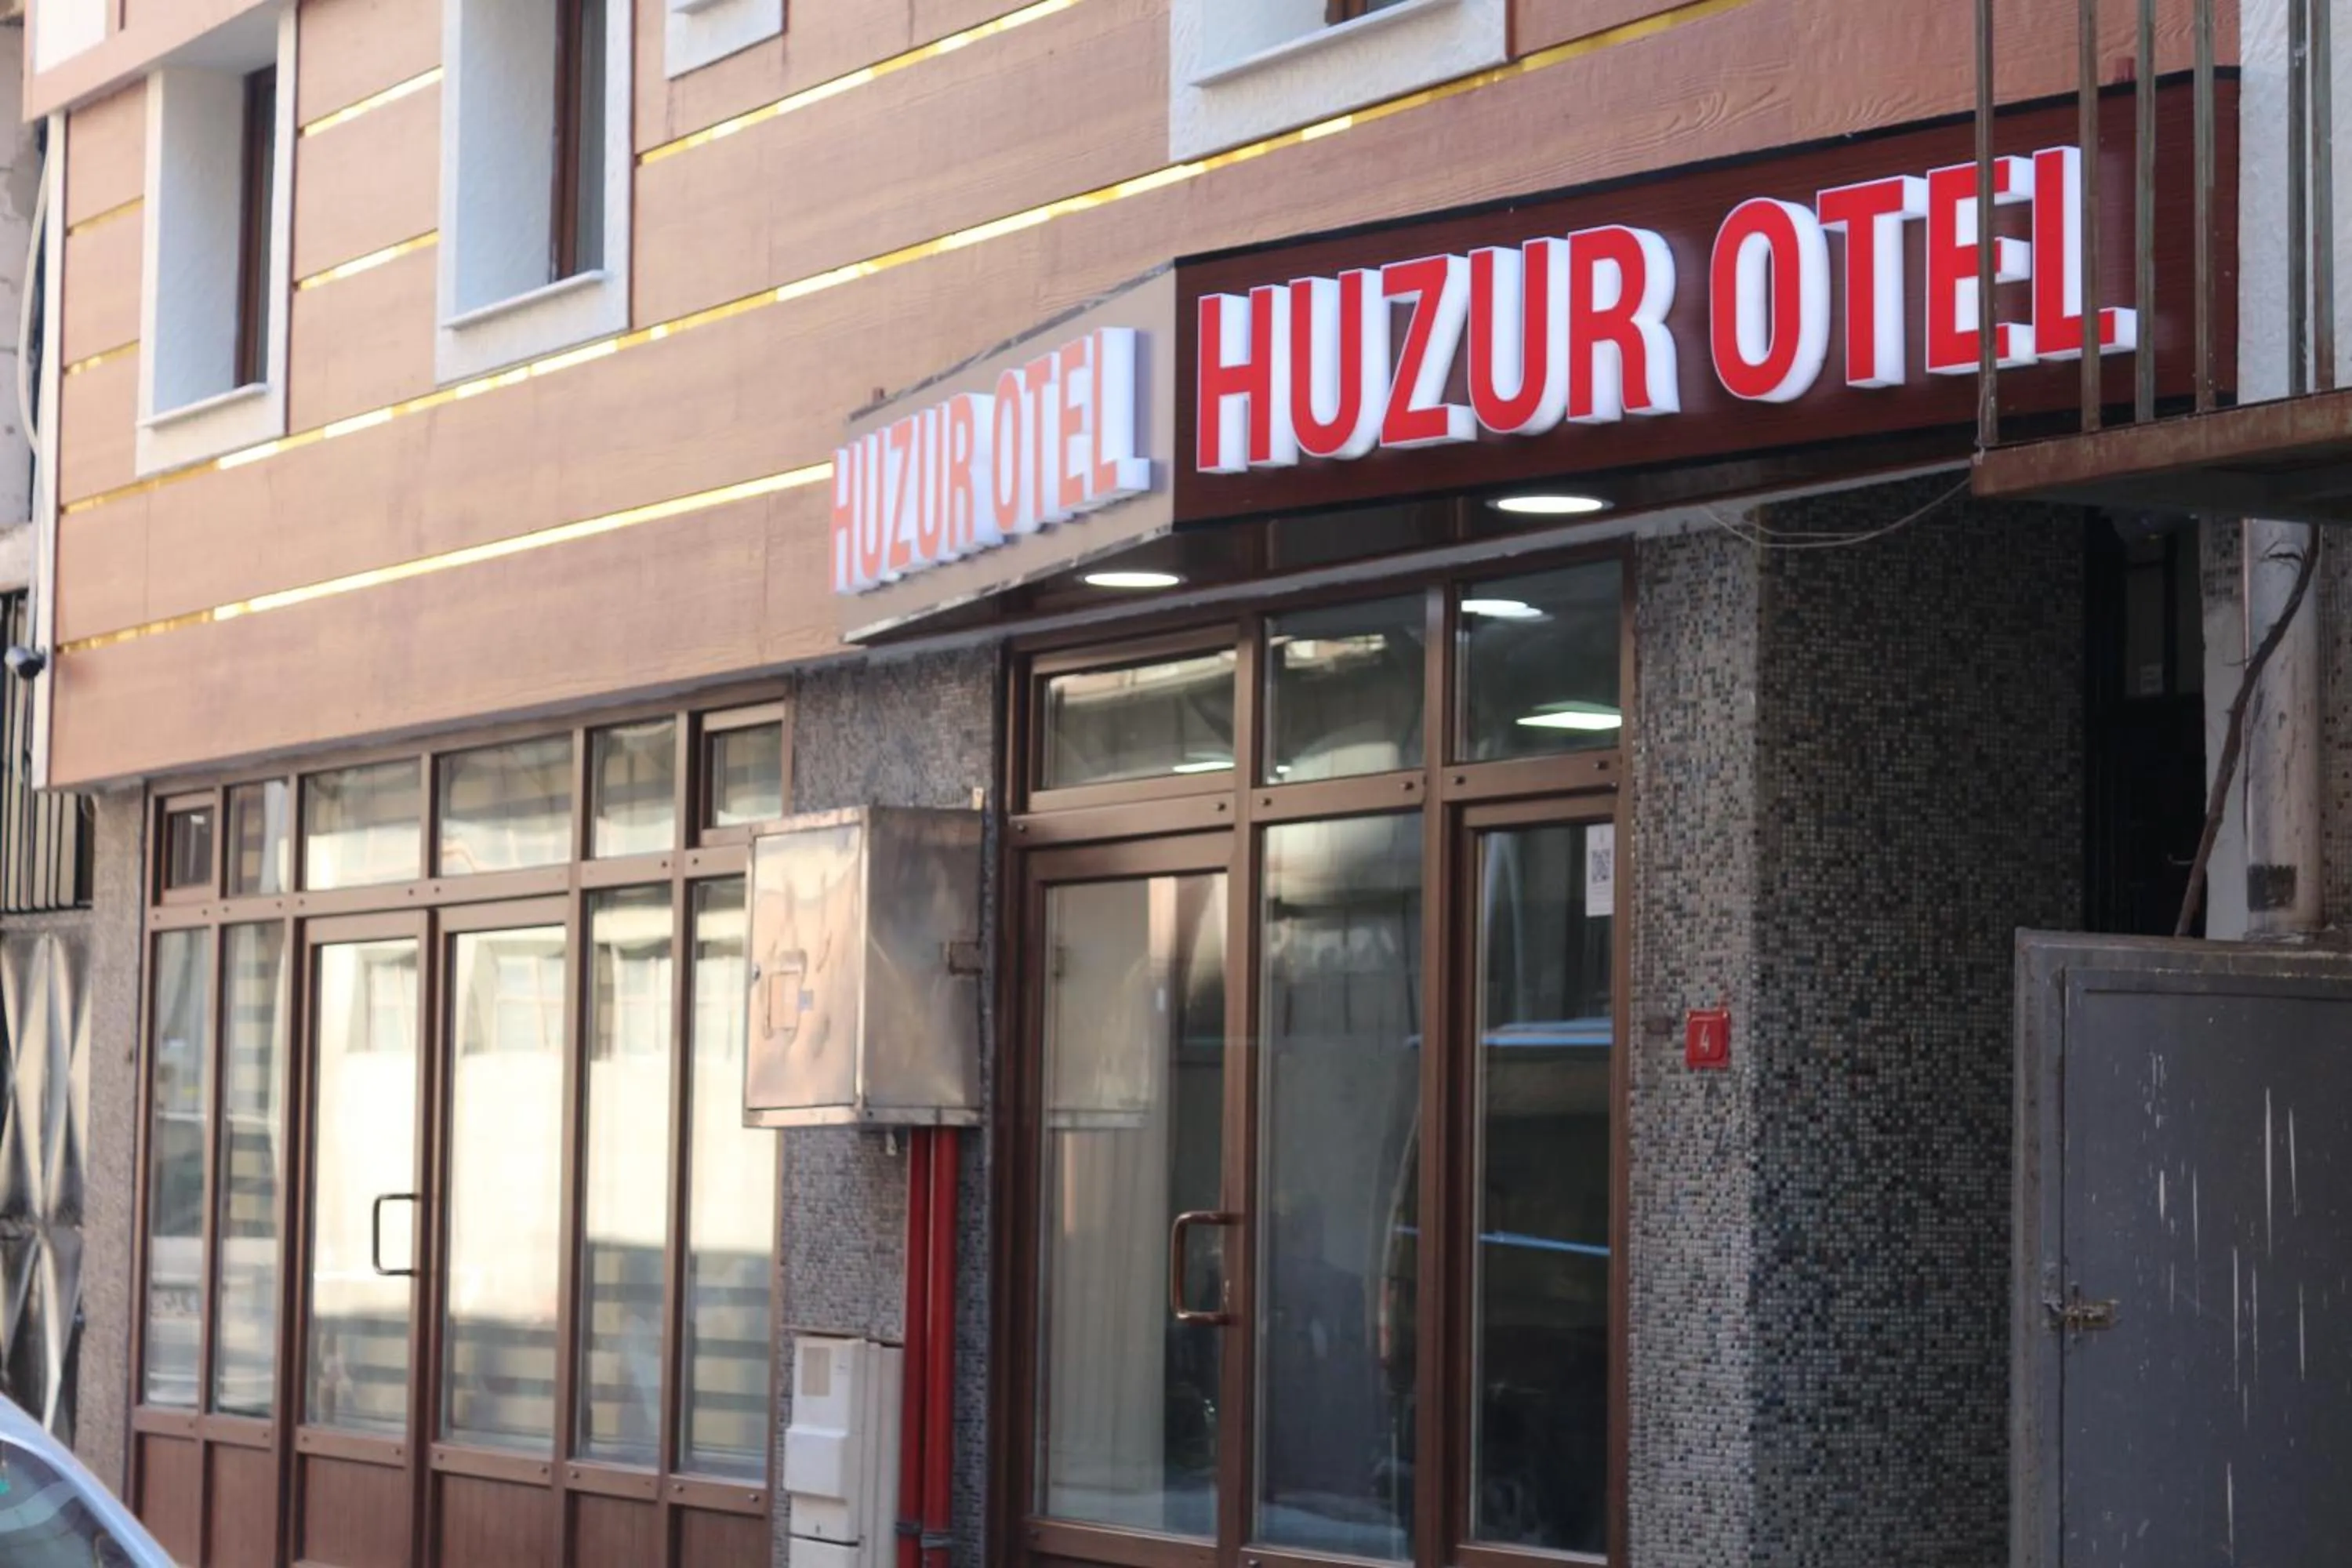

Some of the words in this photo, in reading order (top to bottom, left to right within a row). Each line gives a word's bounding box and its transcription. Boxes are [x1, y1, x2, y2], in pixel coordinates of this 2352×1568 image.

[1197, 224, 1680, 474] HUZUR
[1710, 145, 2137, 403] OTEL
[832, 393, 1002, 594] HUZUR
[992, 327, 1150, 535] OTEL
